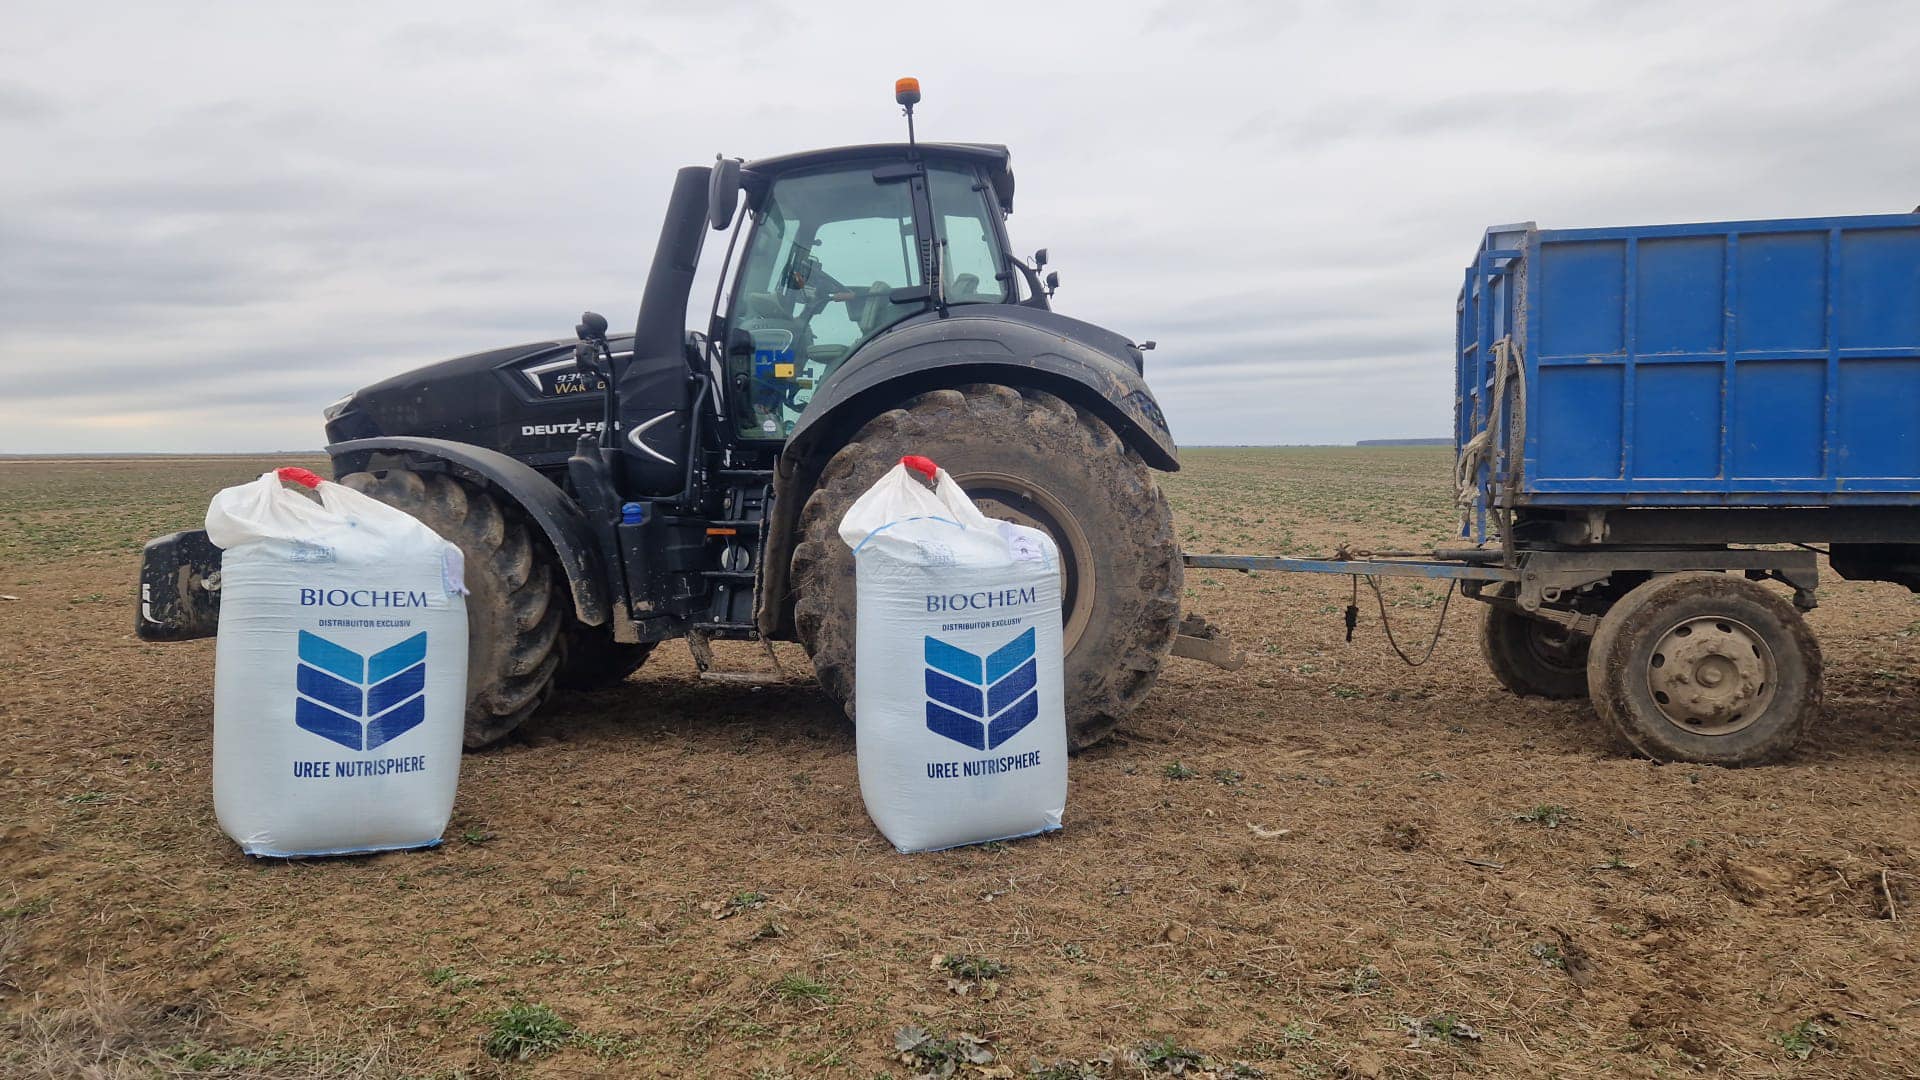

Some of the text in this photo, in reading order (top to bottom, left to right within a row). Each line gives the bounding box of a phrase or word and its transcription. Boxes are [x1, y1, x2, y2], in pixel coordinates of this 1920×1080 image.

[300, 588, 428, 607] BIOCHEM
[926, 587, 1036, 612] BIOCHEM
[318, 619, 411, 628] DISTRIBUITOR EXCLUSIV
[942, 617, 1022, 632] DISTRIBUITOR EXCLUSIV
[294, 755, 426, 778] UREE NUTRISPHERE
[927, 750, 1041, 779] UREE NUTRISPHERE
